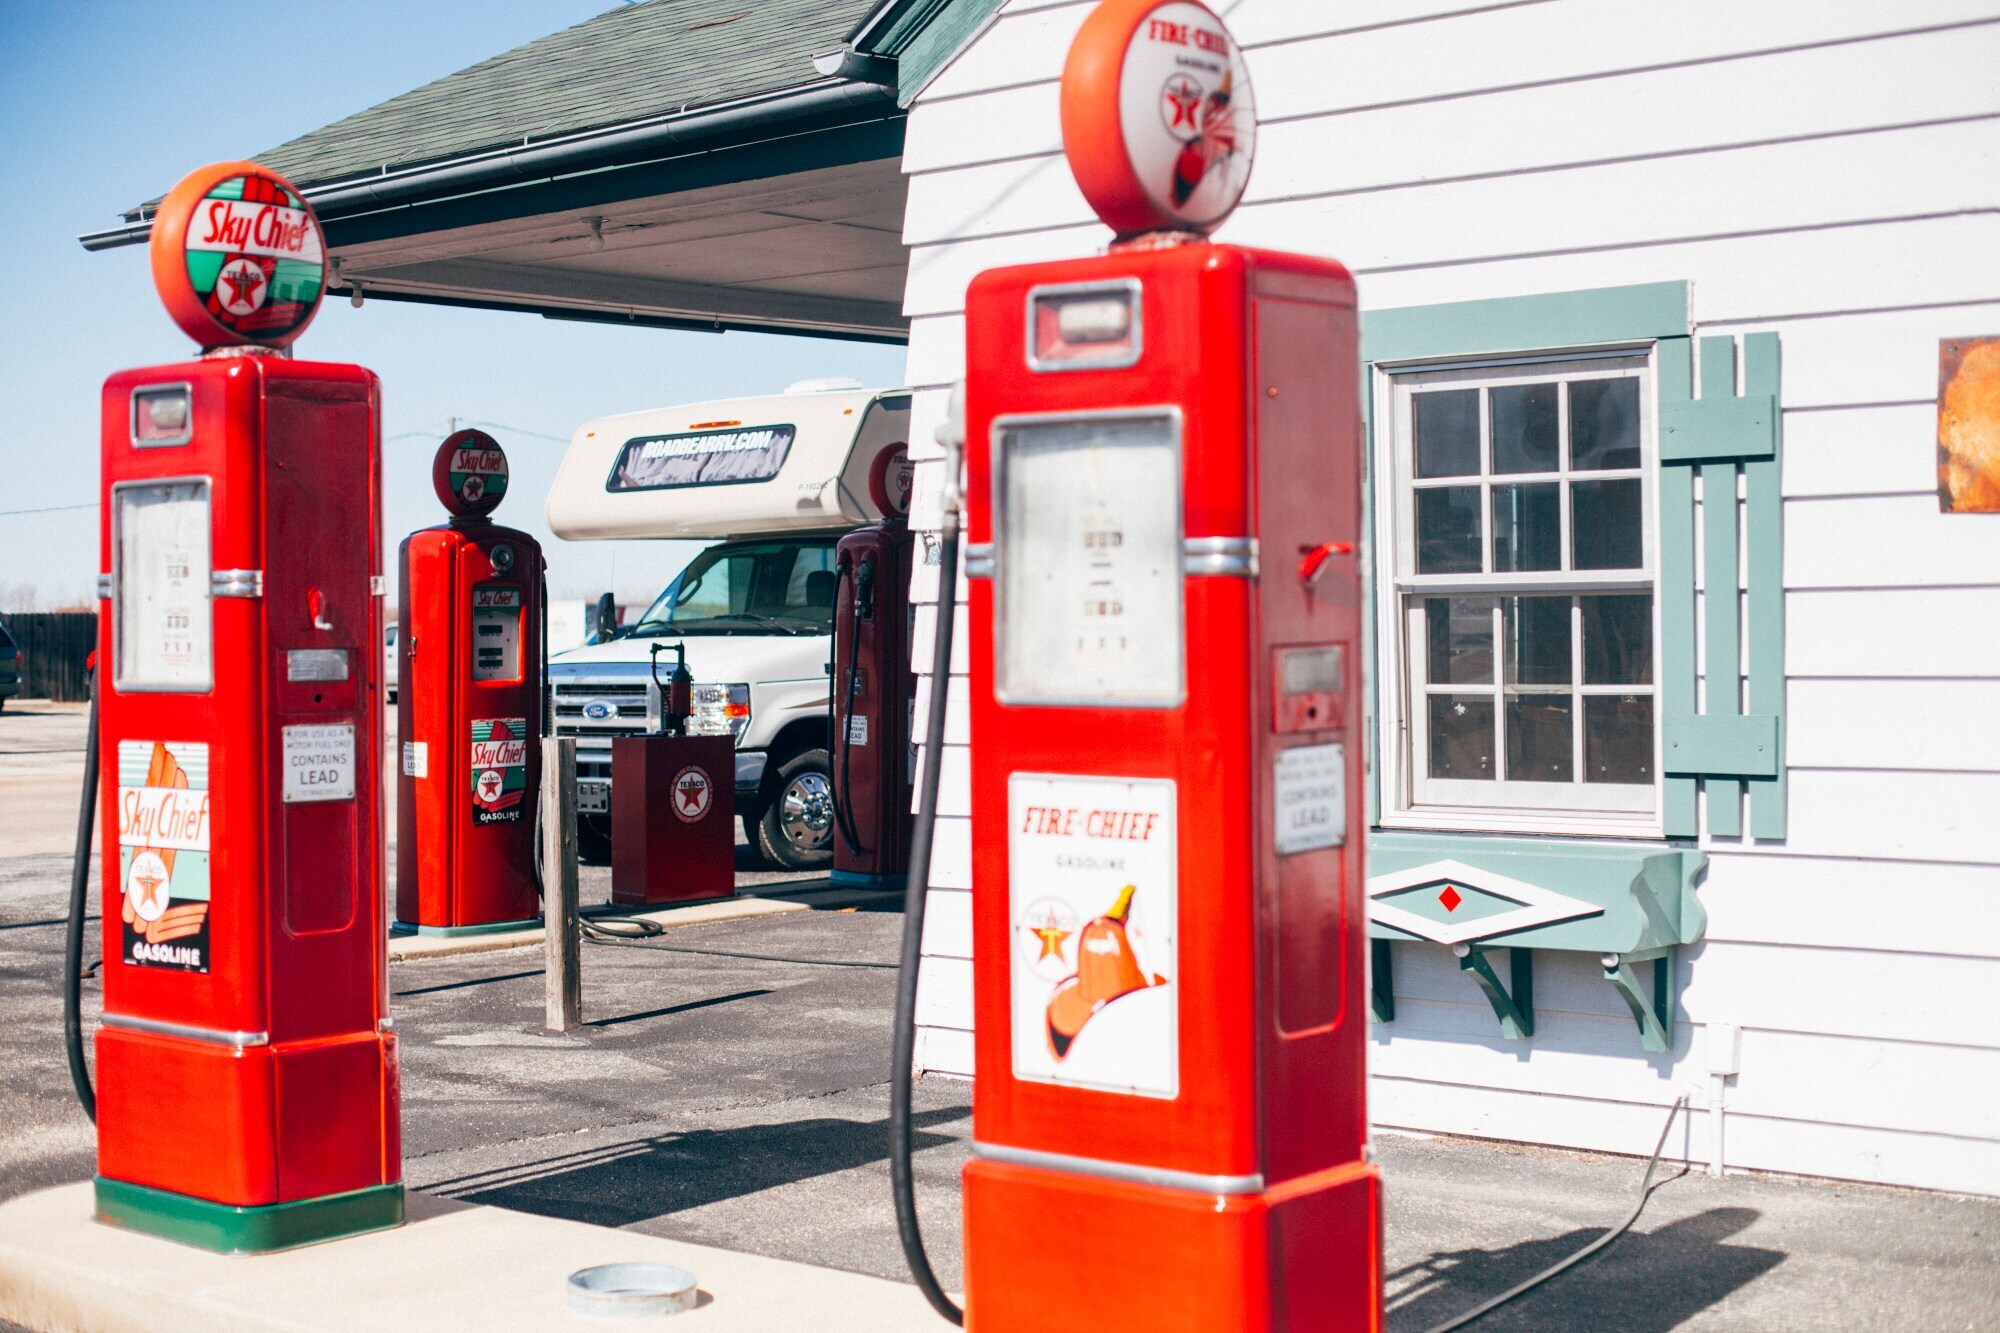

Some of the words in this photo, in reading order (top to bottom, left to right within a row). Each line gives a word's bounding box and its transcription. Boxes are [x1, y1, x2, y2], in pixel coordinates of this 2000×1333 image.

[203, 201, 252, 251] Sky
[254, 205, 309, 252] Chief
[457, 450, 479, 473] Sky
[479, 451, 502, 472] Chief
[478, 590, 492, 607] Sky
[493, 590, 513, 605] Chief
[291, 753, 347, 767] CONTAINS
[473, 742, 496, 769] Sky
[496, 741, 526, 764] Chief
[300, 769, 339, 785] LEAD
[119, 790, 155, 848] Sky
[157, 792, 208, 841] Chief
[479, 811, 521, 822] GASOLINE
[133, 941, 200, 966] GASOLINE
